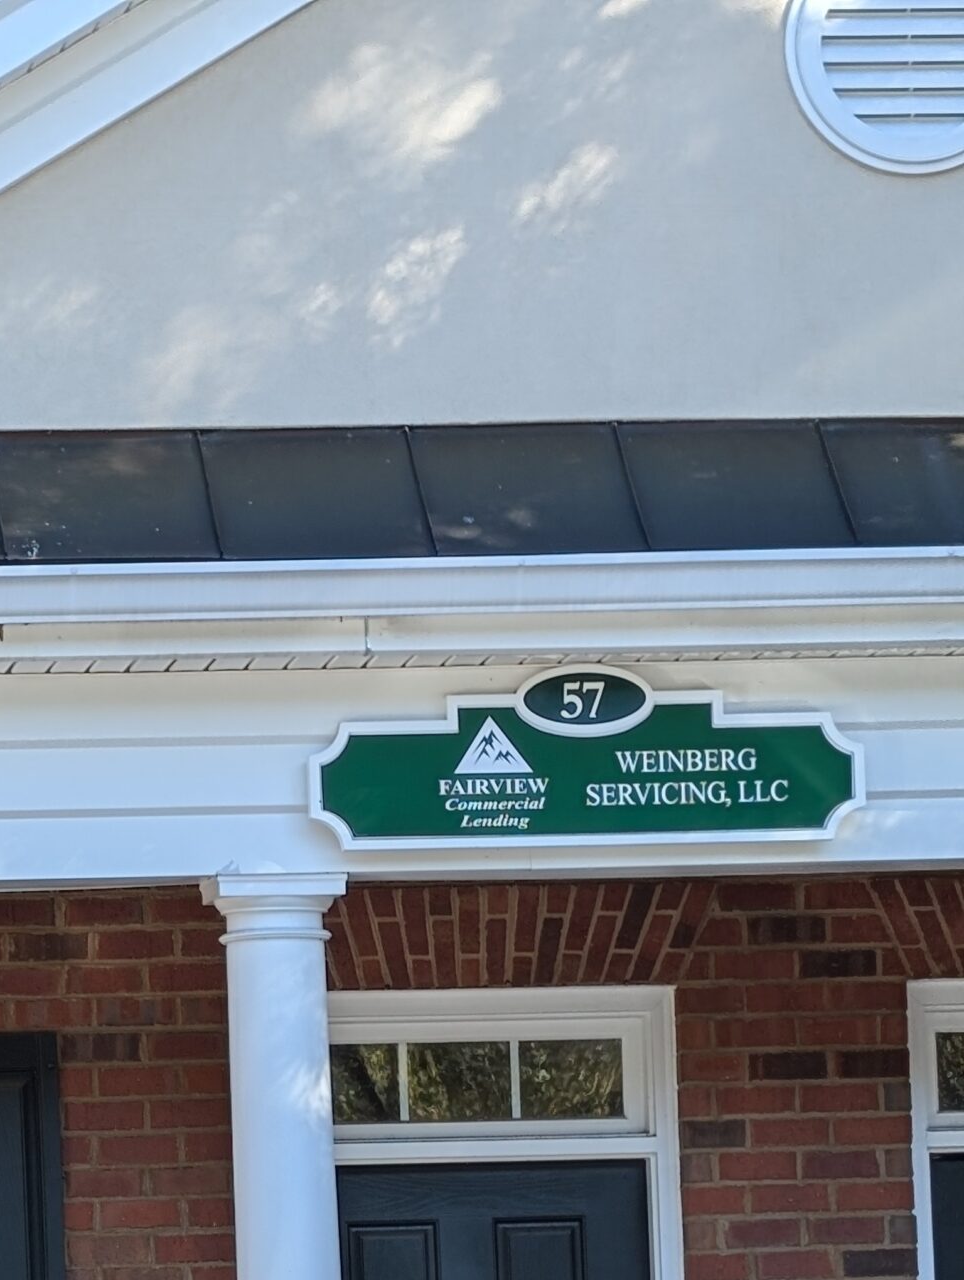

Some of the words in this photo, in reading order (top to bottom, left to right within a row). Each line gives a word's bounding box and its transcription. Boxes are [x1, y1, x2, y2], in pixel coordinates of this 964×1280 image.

[560, 681, 605, 719] 57
[615, 748, 757, 773] WEINBERG
[438, 778, 549, 796] FAIRVIEW
[586, 781, 732, 807] SERVICING,
[738, 780, 788, 803] LLC
[445, 797, 545, 811] Commercial
[460, 814, 530, 829] Lending
